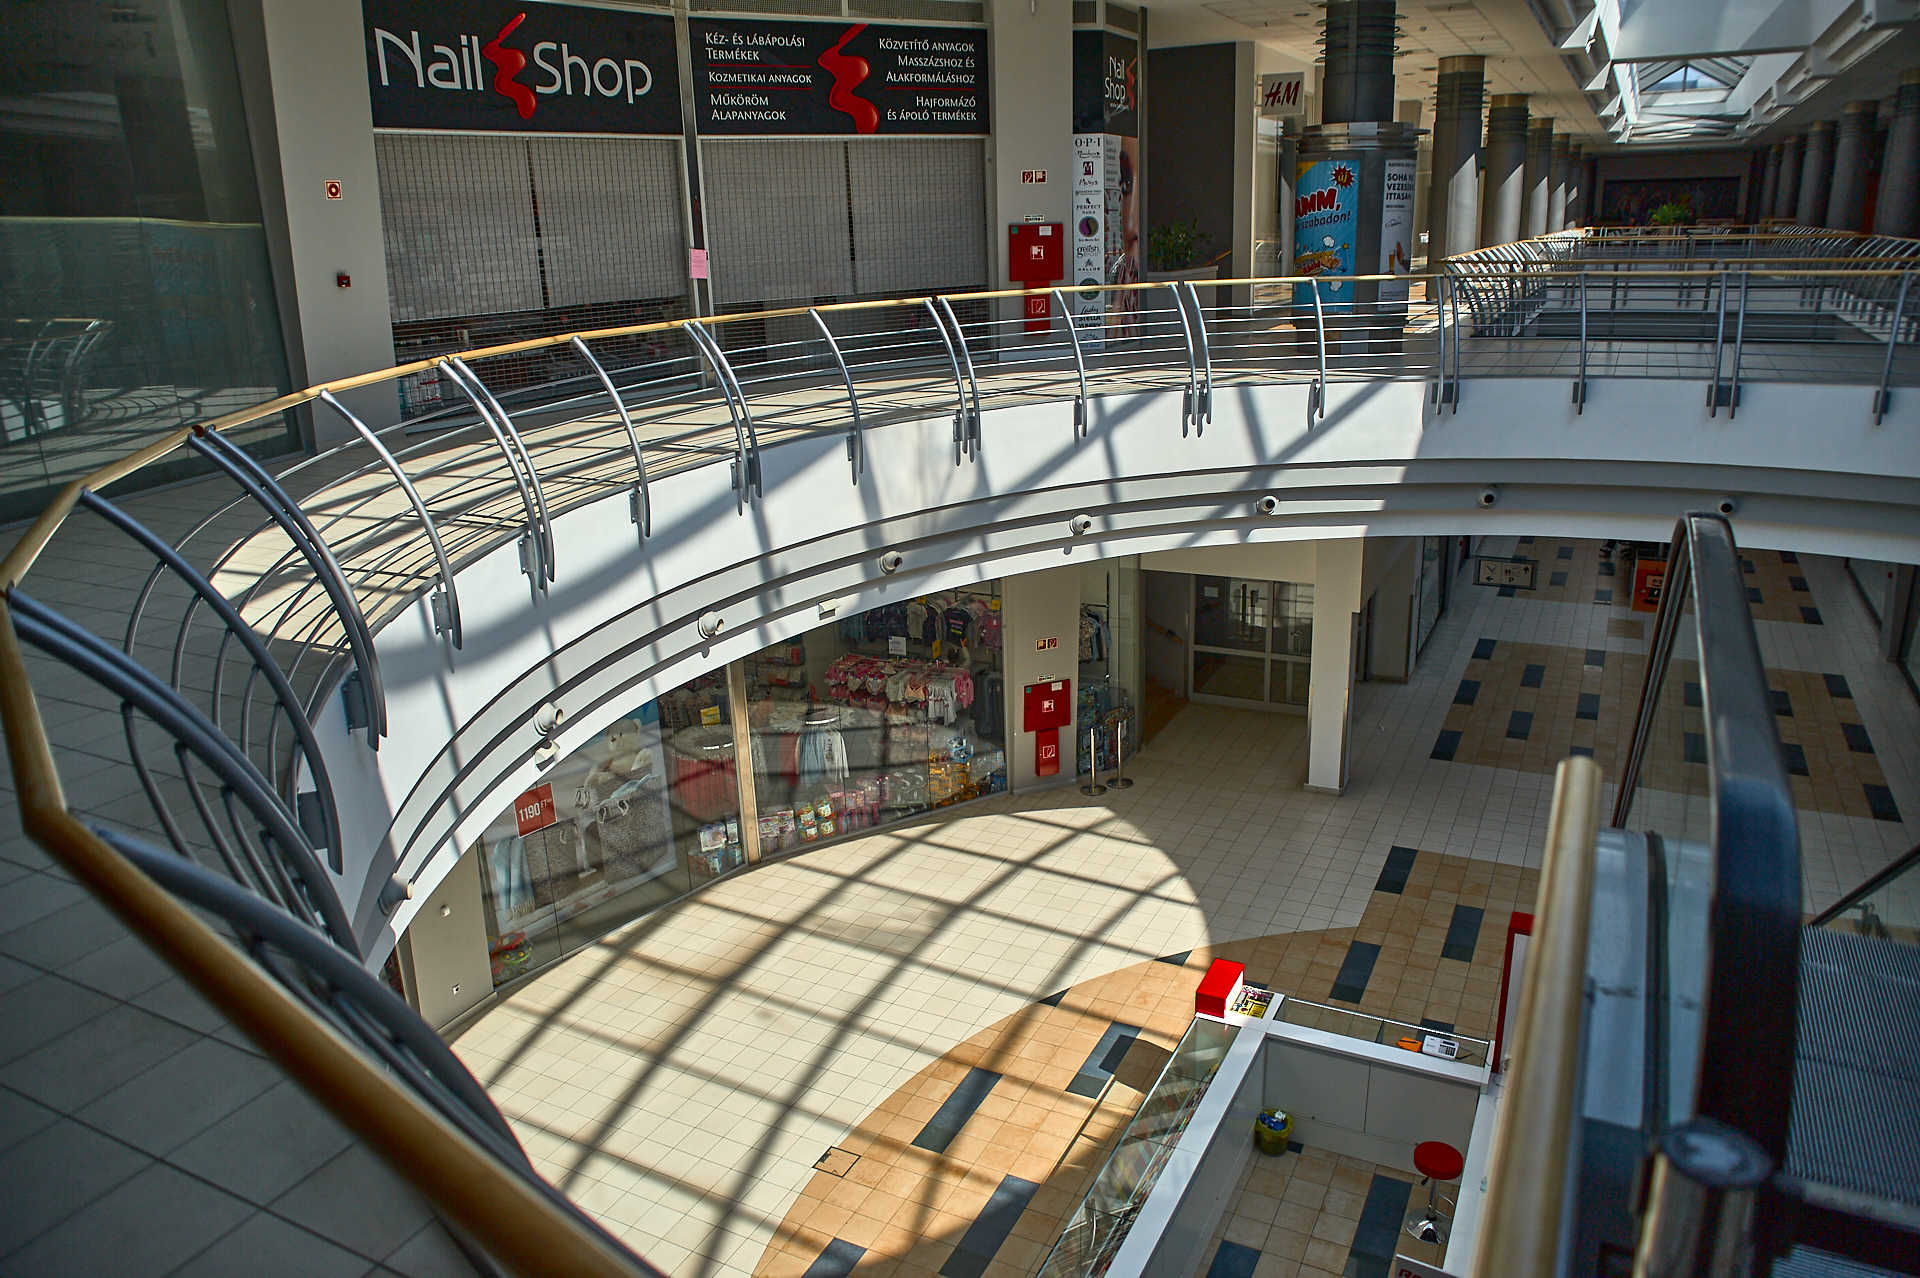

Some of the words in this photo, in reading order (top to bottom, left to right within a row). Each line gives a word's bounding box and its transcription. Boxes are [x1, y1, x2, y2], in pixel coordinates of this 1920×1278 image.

[705, 32, 729, 45] KÉZ-
[732, 32, 743, 45] ÉS
[747, 33, 805, 47] LÁBÁPOLÁSI
[879, 38, 930, 51] KÖZVETÍTŐ
[931, 42, 975, 52] ANYAGOK
[705, 47, 760, 61] TERMÉKEK
[374, 27, 484, 91] Nail
[533, 41, 653, 104] Shop
[898, 55, 963, 68] MASSZÁZSHOZ
[965, 56, 975, 68] ÉS
[708, 71, 766, 83] KOZMETIKAI
[768, 74, 812, 84] ANYAGOK
[886, 71, 975, 84] ALAKFORMÁLÁSHOZ
[1104, 76, 1126, 104] Shop
[710, 93, 769, 106] MŰKÖRÖM
[916, 95, 976, 108] HAJFORMÁZÓ
[712, 109, 787, 121] ALAPANYAGOK
[887, 108, 897, 121] ÉS
[899, 108, 930, 121] ÁPOLÓ
[931, 109, 977, 121] TERMÉKEK
[1387, 173, 1408, 182] SOHA
[519, 802, 541, 822] 1190
